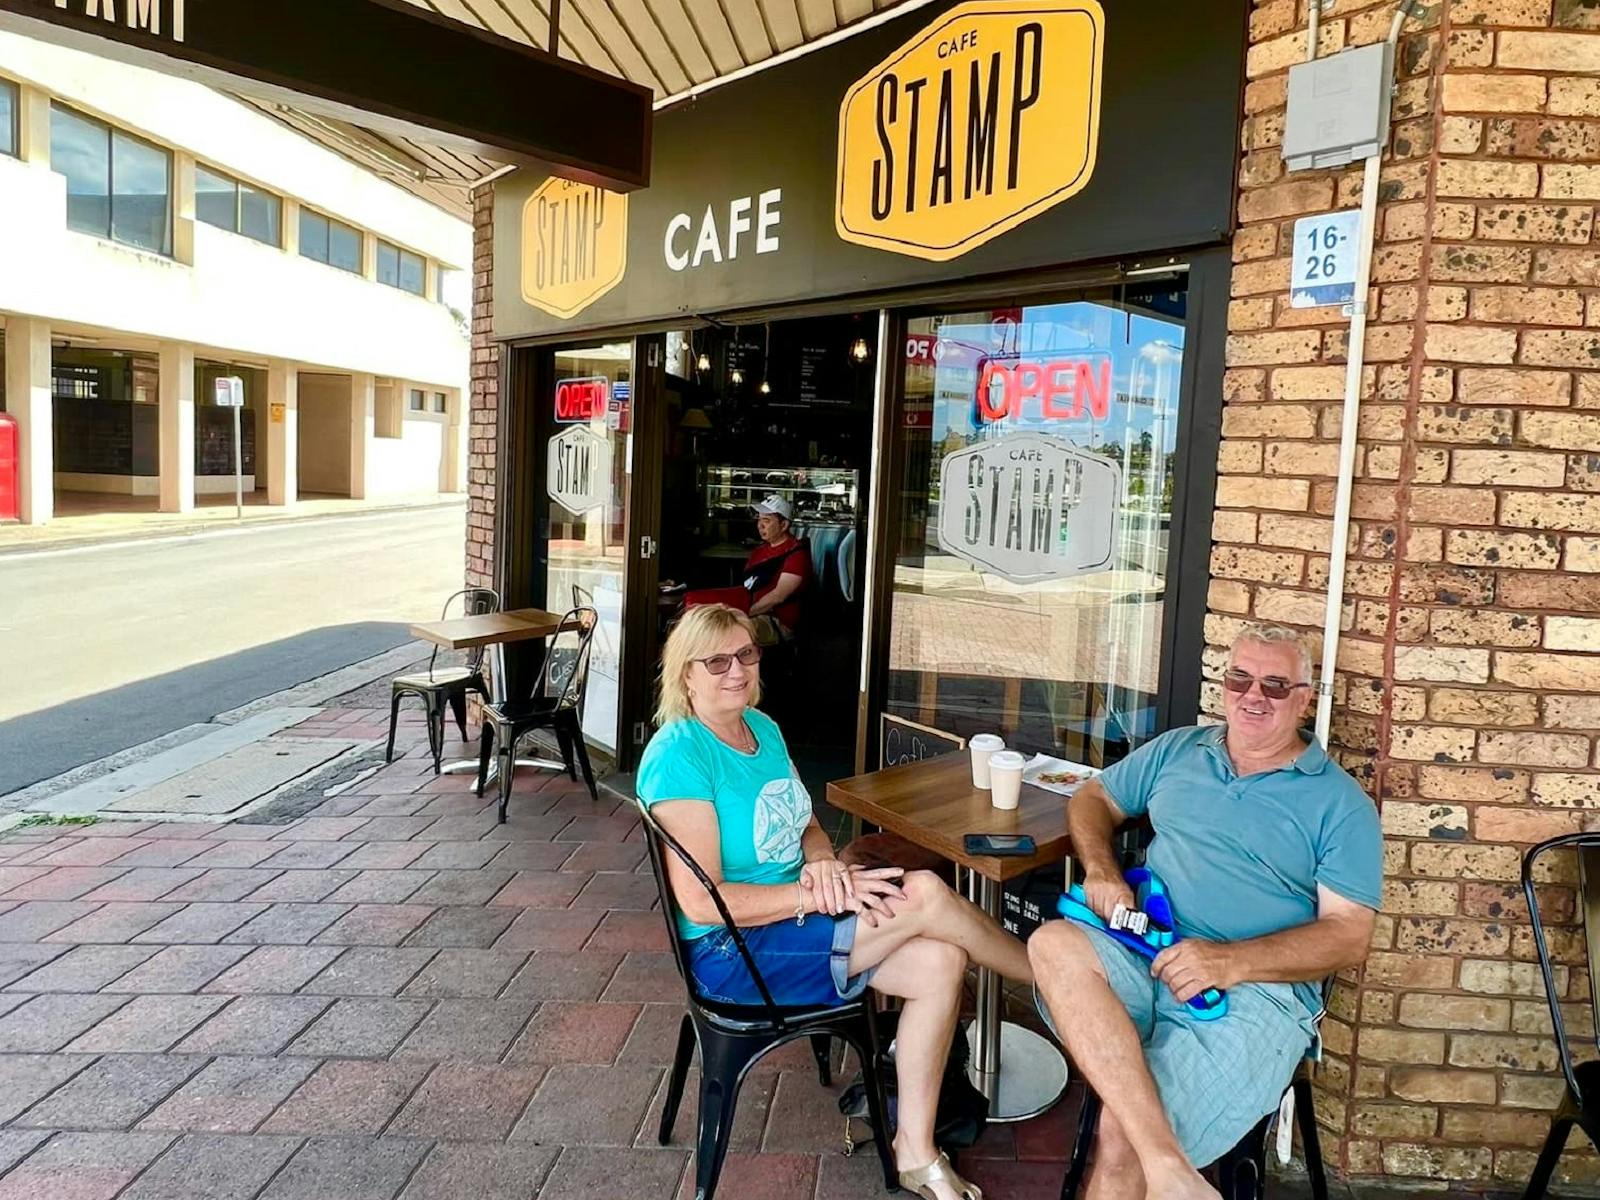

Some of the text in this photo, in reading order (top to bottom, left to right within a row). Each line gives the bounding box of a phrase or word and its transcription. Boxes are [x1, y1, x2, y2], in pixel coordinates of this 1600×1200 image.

[937, 29, 978, 59] CAFE
[871, 22, 1043, 221] STAMP
[664, 188, 782, 271] CAFE
[1307, 225, 1347, 251] 16-
[1305, 254, 1336, 280] 26
[556, 383, 607, 417] OPEN
[978, 358, 1111, 421] OPEN
[557, 438, 599, 497] STAMP
[1009, 449, 1043, 462] CAFE
[964, 454, 1083, 555] STAMP
